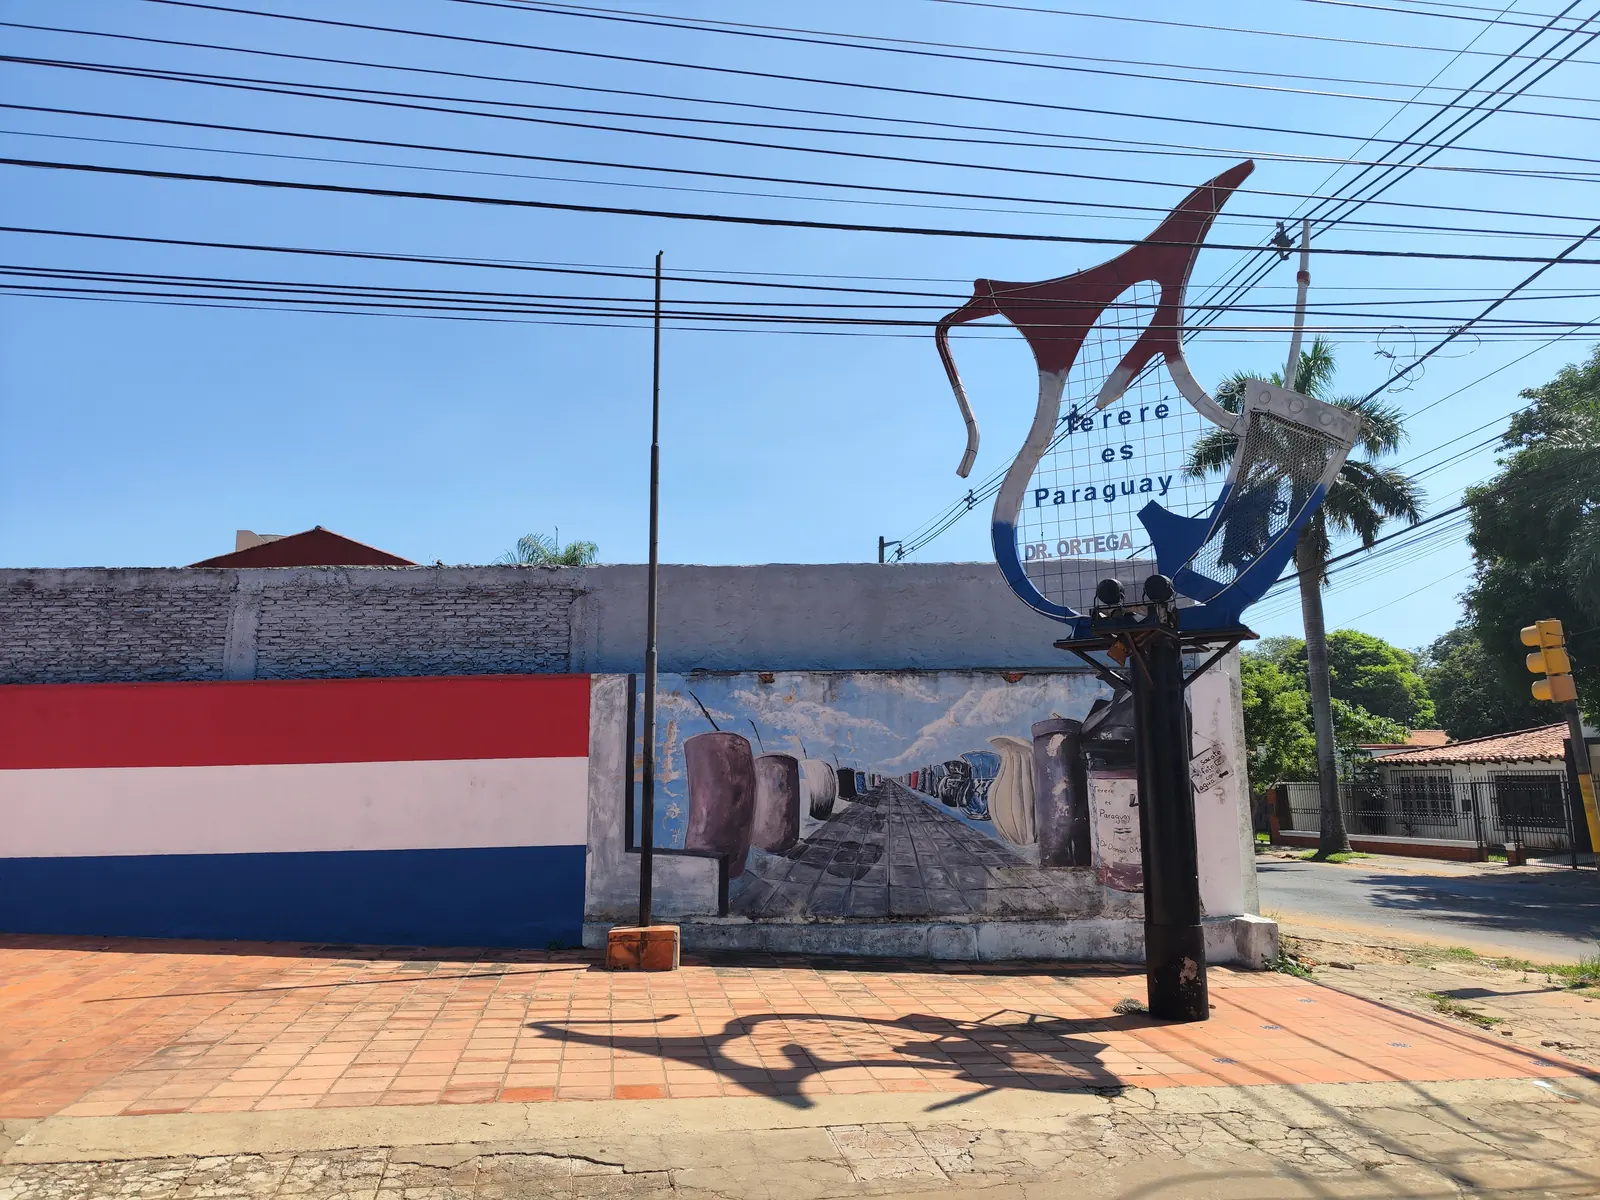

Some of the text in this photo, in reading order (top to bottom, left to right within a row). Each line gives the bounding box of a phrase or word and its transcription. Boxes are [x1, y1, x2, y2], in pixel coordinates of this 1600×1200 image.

[1101, 444, 1134, 462] es
[1035, 475, 1173, 508] Paraguay
[1025, 533, 1133, 560] DR. ORTEGA
